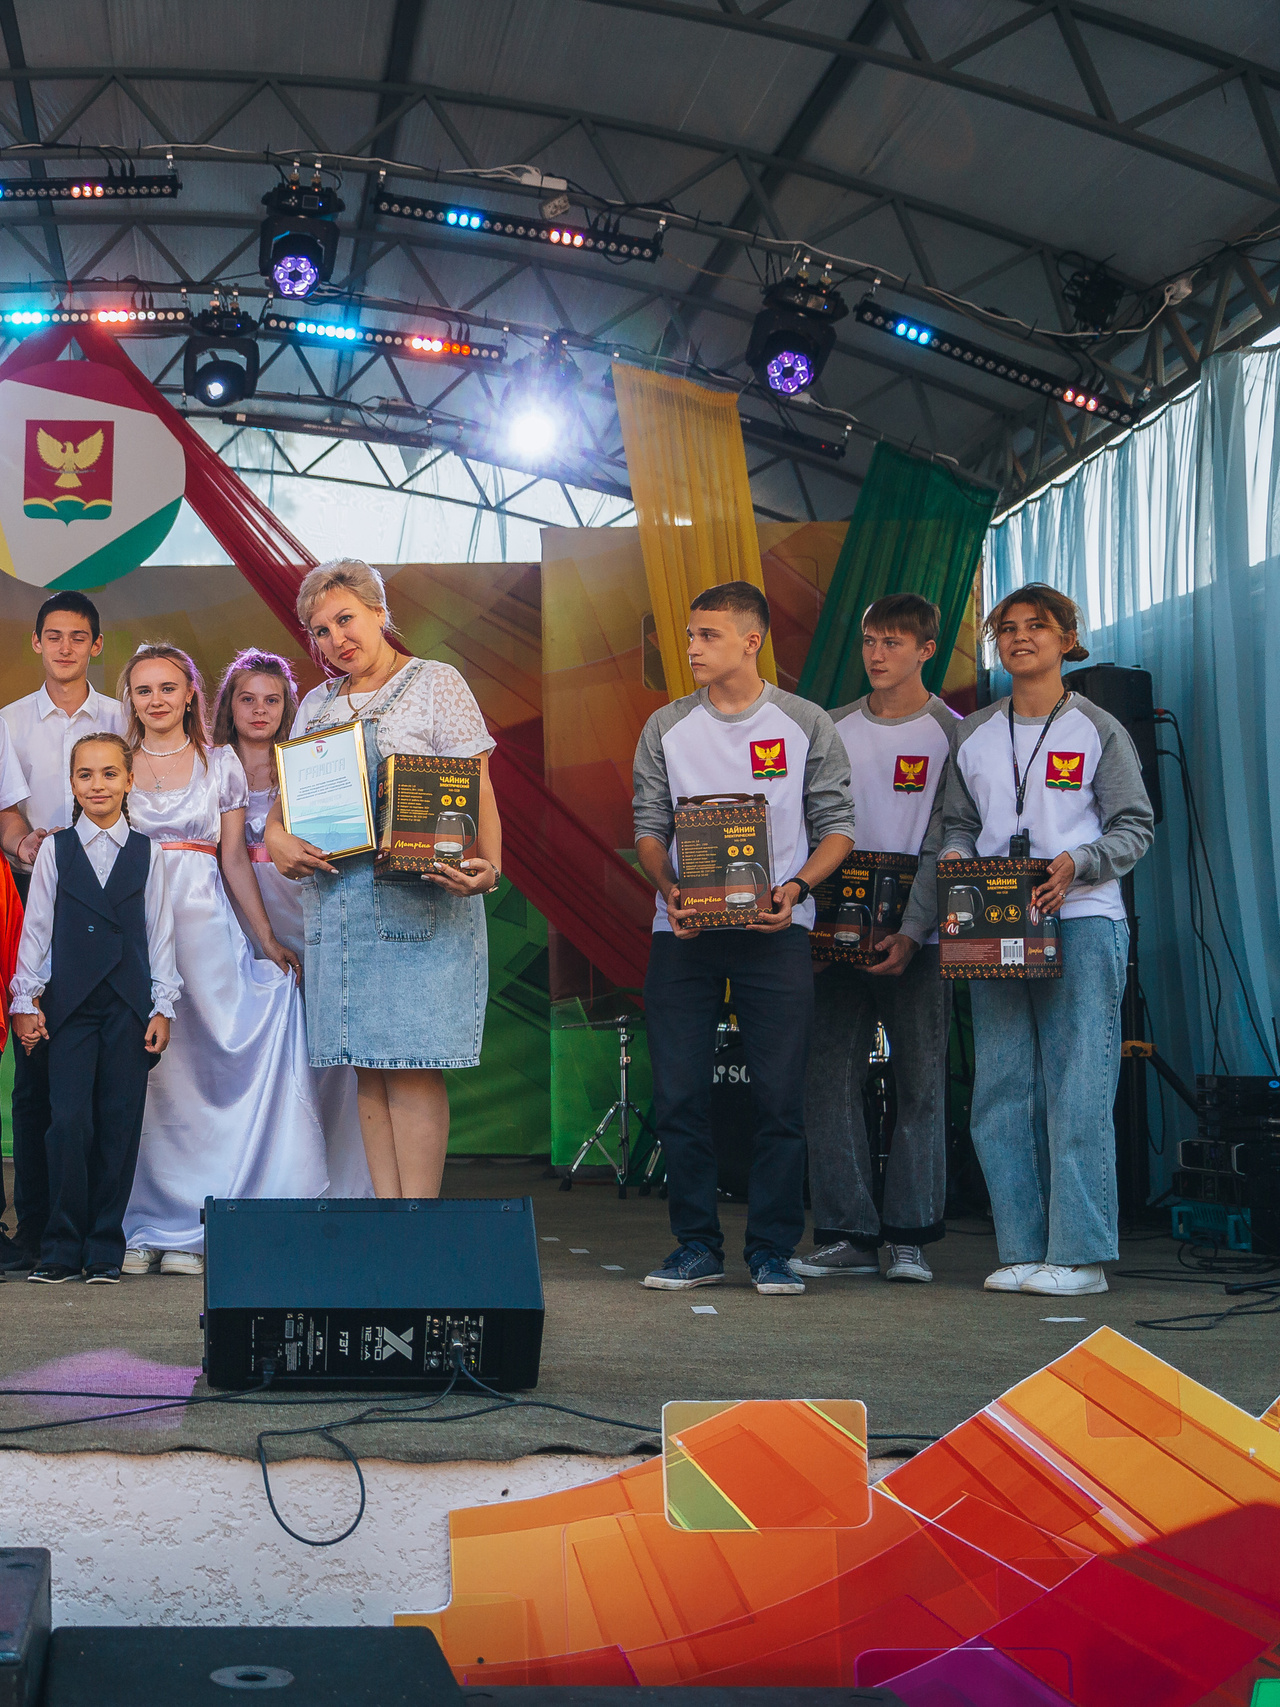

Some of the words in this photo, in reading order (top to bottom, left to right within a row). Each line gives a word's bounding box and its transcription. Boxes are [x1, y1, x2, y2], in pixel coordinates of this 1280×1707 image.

[439, 775, 470, 784] ЧАЙНИК
[723, 825, 756, 834] ЧАЙНИК
[842, 868, 870, 876] ЧАЙНИК
[986, 877, 1018, 886] ЧАЙНИК
[374, 1326, 383, 1361] PRO
